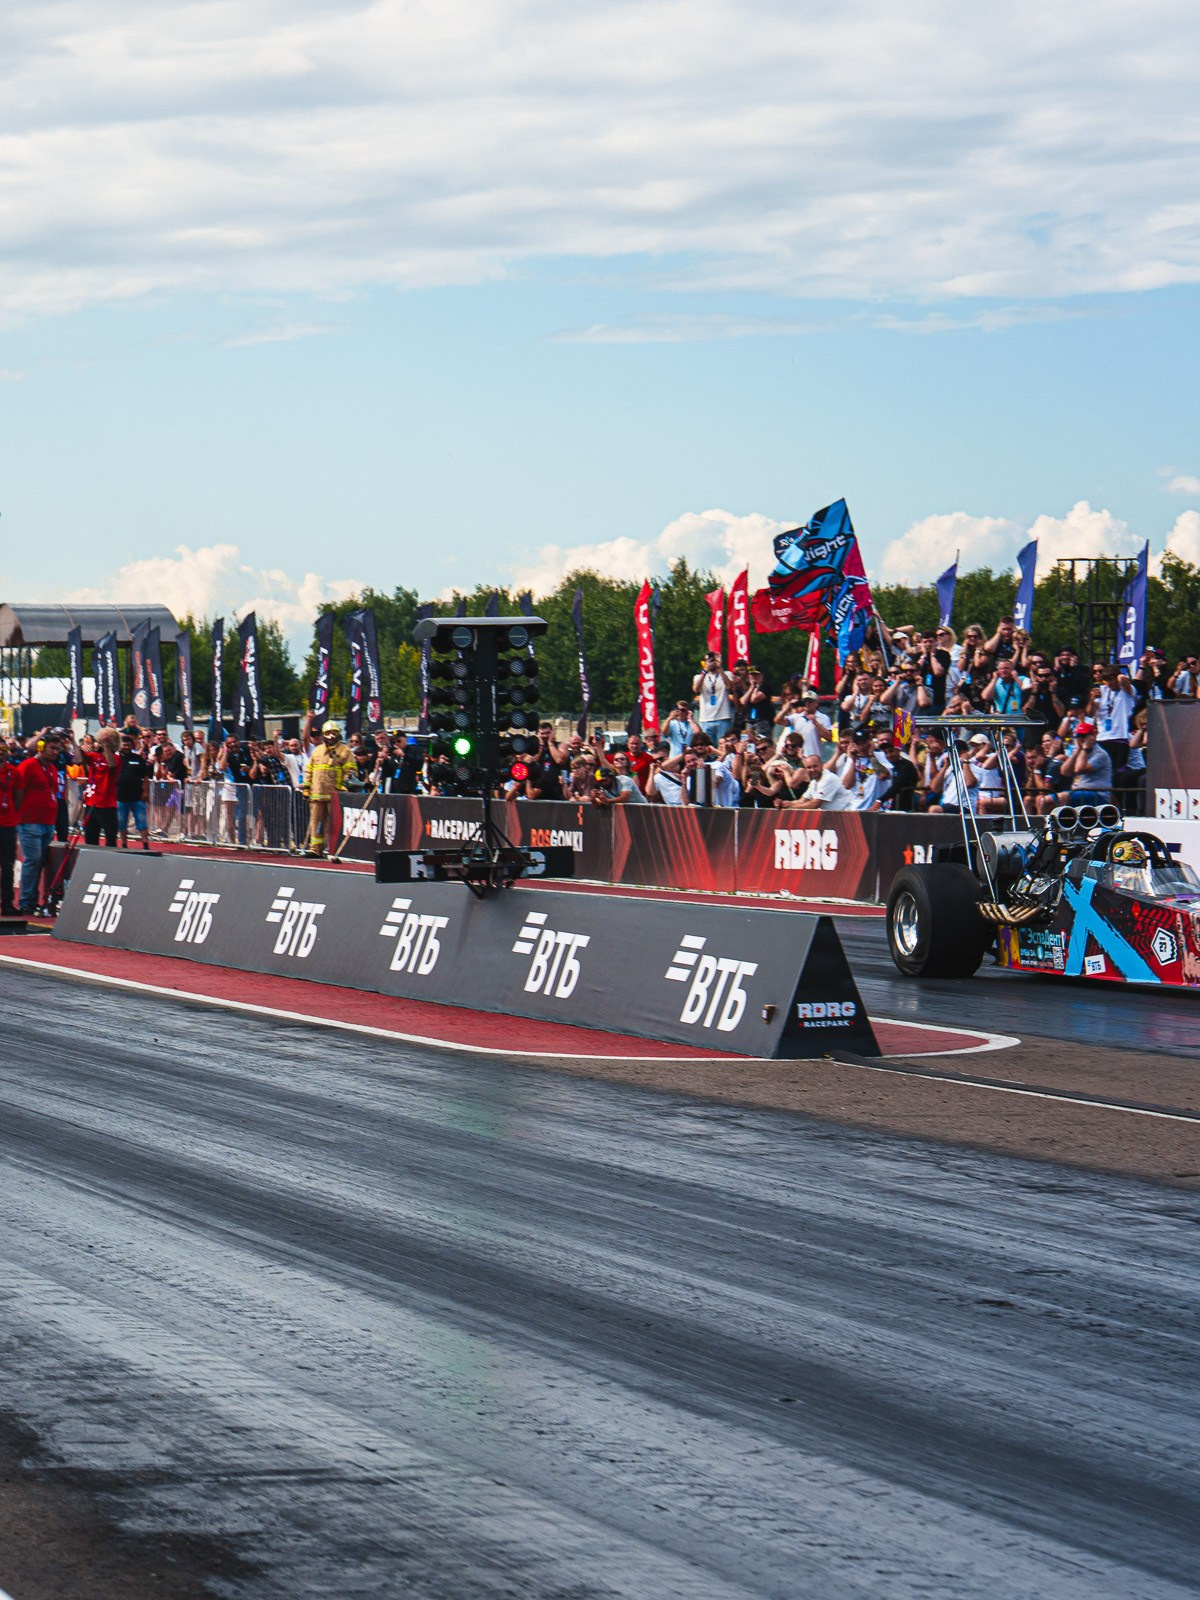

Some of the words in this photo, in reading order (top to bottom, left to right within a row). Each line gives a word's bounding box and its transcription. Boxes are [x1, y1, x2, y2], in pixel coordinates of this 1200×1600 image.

[531, 828, 583, 852] ROSGONKI
[87, 884, 130, 934] ВТБ
[174, 891, 221, 944] ВТБ
[273, 900, 326, 958] ВТБ
[390, 913, 450, 976] ВТБ
[523, 929, 591, 999] ВТБ
[680, 954, 759, 1033] ВТБ
[803, 1020, 850, 1028] RACEPARK
